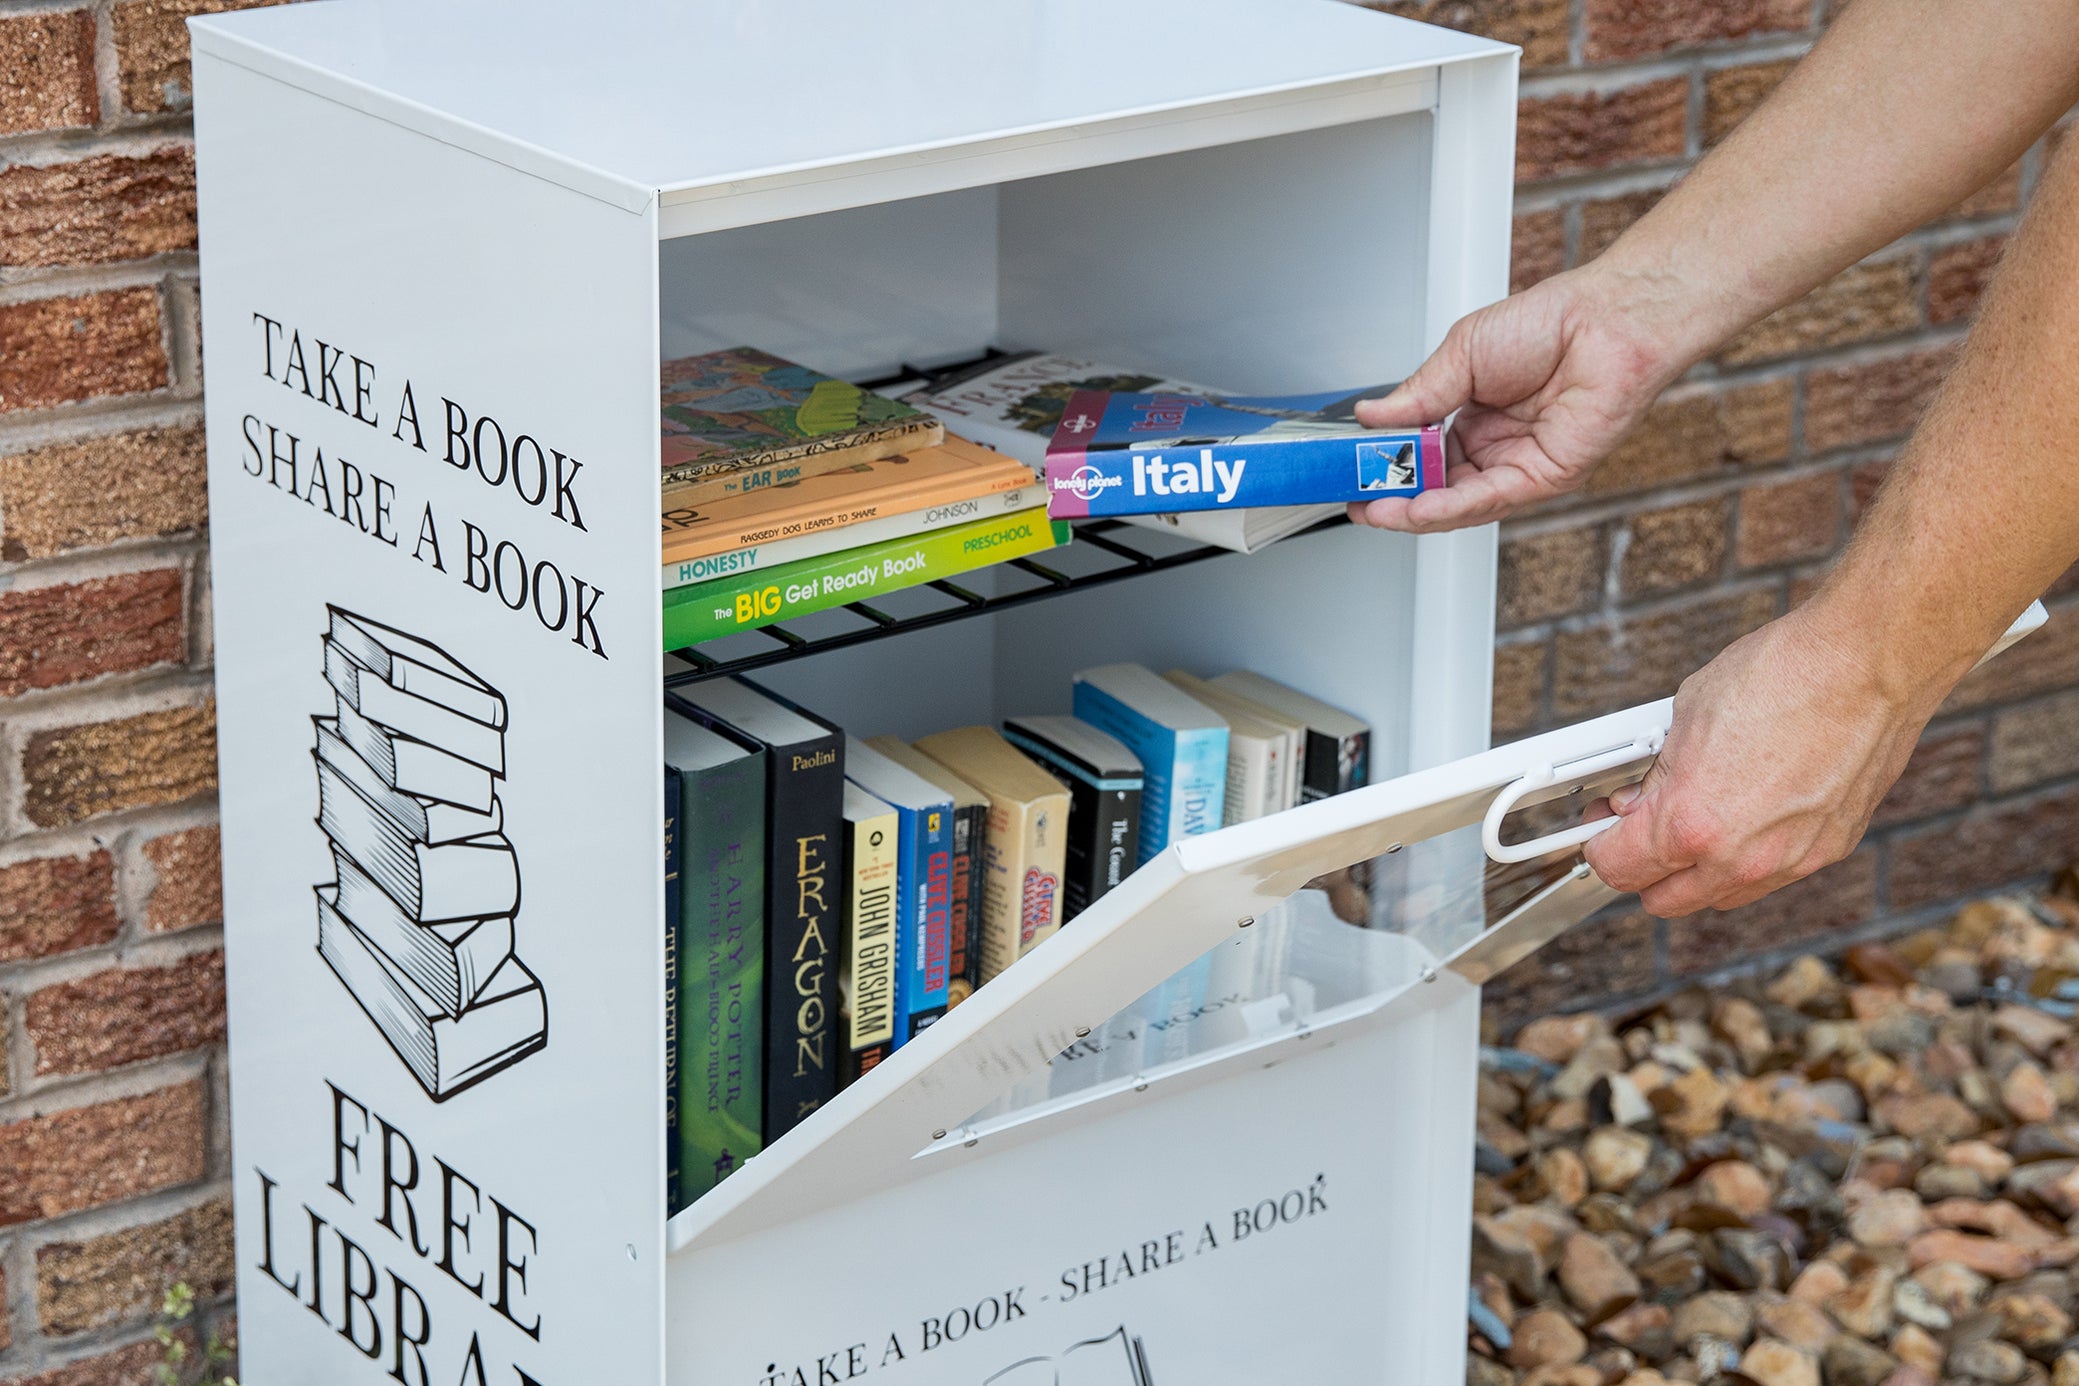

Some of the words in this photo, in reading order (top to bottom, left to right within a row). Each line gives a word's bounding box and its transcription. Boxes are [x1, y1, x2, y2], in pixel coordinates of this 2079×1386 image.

[252, 312, 379, 428] TAKE
[392, 379, 428, 453] A
[440, 396, 588, 532] BOOK
[1129, 392, 1205, 433] Italy
[743, 471, 772, 491] EAR
[1054, 476, 1087, 492] lonely
[1087, 474, 1122, 490] planet
[1132, 449, 1246, 503] Italy
[242, 414, 398, 547] SHARE
[412, 500, 447, 574] A
[461, 519, 609, 660] BOOK
[740, 528, 779, 544] RAGGEDY
[783, 523, 801, 535] DOG
[804, 516, 834, 530] LEARNS
[838, 514, 848, 523] TO
[851, 508, 877, 520] SHARE
[923, 501, 978, 524] JOHNSON
[963, 524, 1033, 554] PRESCHOOL
[679, 548, 758, 581] HONESTY
[714, 607, 733, 620] The
[735, 586, 782, 624] BIG
[785, 579, 818, 604] Get
[823, 565, 878, 595] Ready
[883, 550, 927, 580] Book
[792, 749, 836, 771] Paolini
[1111, 817, 1129, 844] The
[1184, 798, 1207, 835] DAV
[726, 842, 744, 967] HARRY
[927, 851, 949, 909] CLIVE
[1037, 874, 1057, 925] CLIVE
[859, 886, 891, 940] JOHN
[792, 834, 828, 1078] ERAGON
[924, 910, 947, 994] CUSSLER
[856, 942, 889, 1038] GRISHAM
[726, 983, 743, 1108] POTTER
[325, 1078, 541, 1342] FREE
[254, 1166, 546, 1386] LIBR
[880, 1332, 905, 1368] A
[920, 1285, 1026, 1351] BOOK
[1060, 1230, 1185, 1302] SHARE
[1195, 1220, 1218, 1255] A
[1232, 1181, 1328, 1242] BOOK
